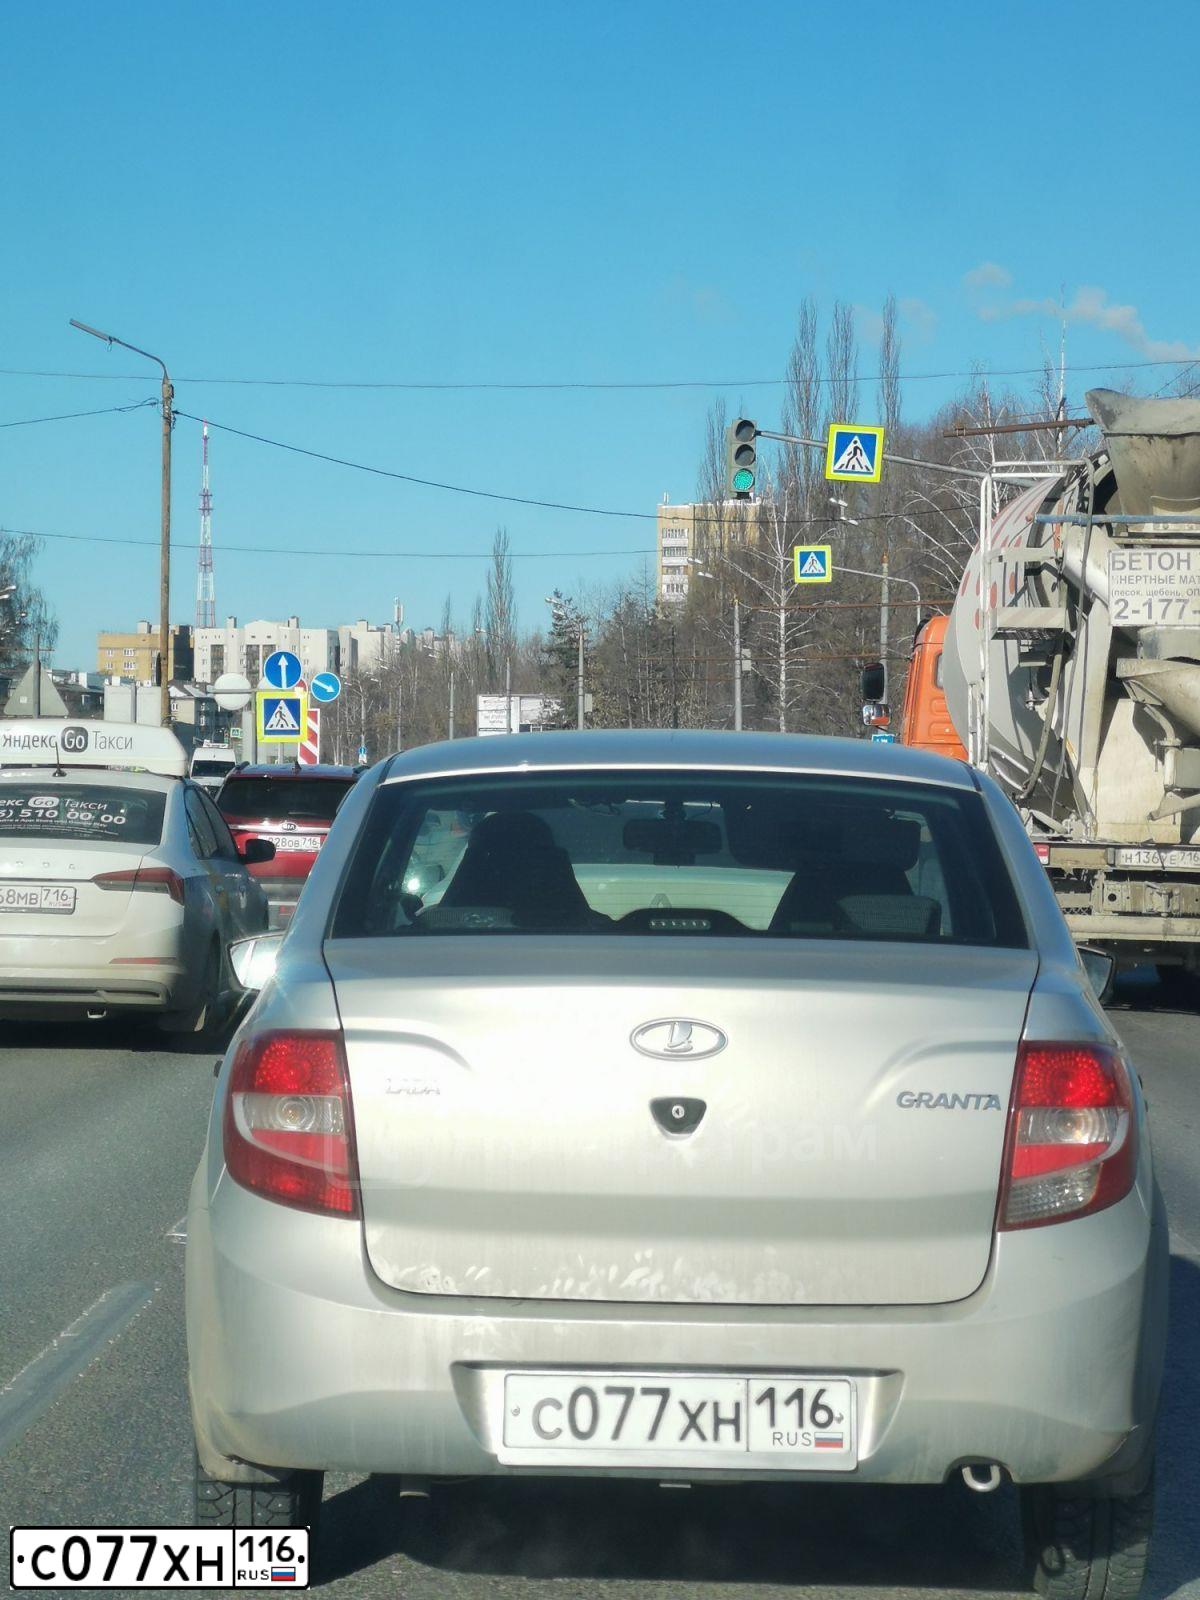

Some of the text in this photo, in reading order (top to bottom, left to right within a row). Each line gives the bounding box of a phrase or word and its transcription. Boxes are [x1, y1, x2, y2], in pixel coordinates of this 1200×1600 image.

[1111, 552, 1191, 571] БЕТОН
[3, 729, 133, 750] Яндекс Go Такси
[63, 798, 108, 810] Такси
[19, 809, 58, 818] 510
[43, 888, 69, 902] 716
[896, 1091, 1001, 1111] GRANTA
[531, 1386, 834, 1442] С077ХН 116
[772, 1431, 812, 1447] RUS
